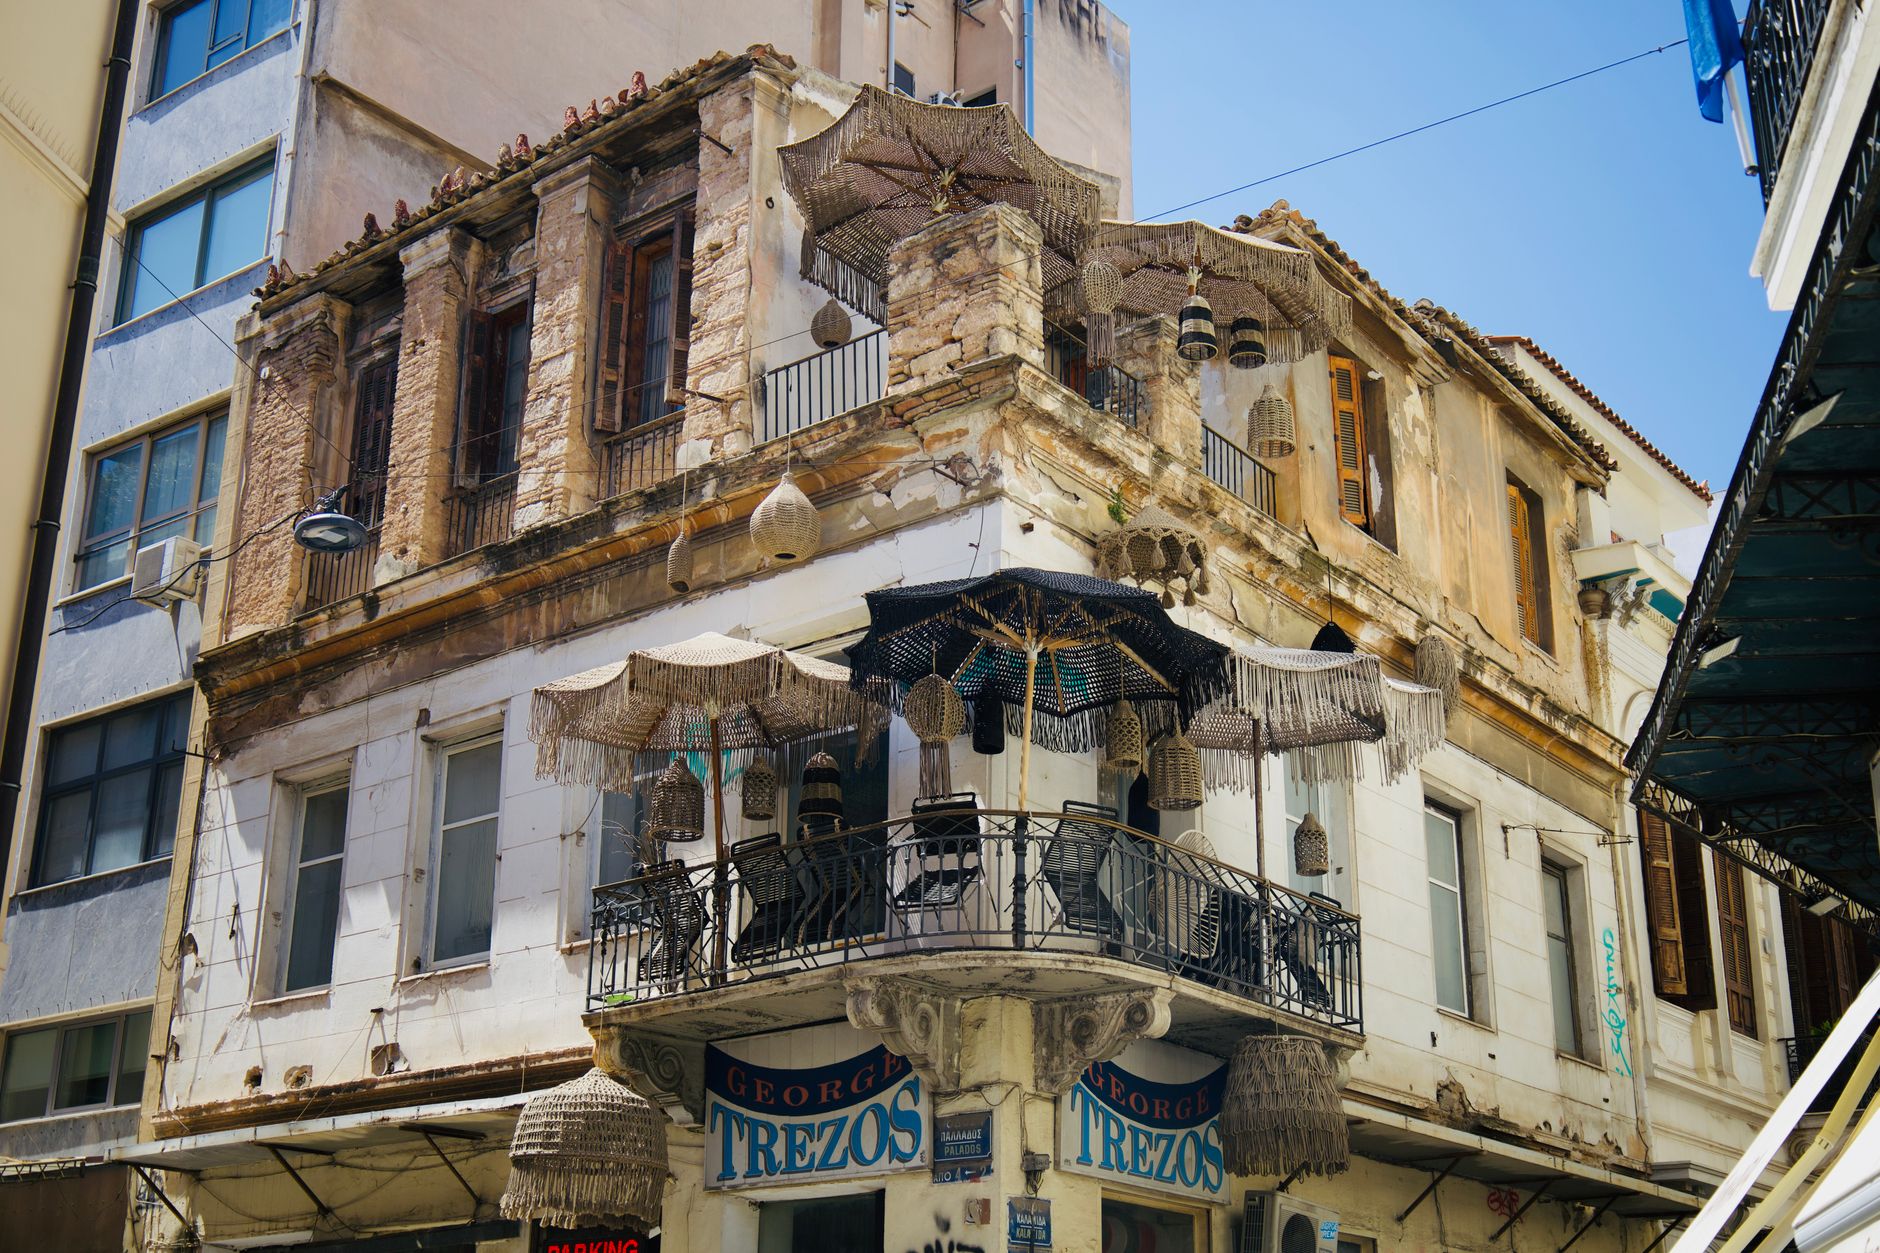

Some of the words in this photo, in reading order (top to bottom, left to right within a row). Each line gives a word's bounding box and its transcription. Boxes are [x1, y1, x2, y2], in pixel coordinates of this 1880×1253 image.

[727, 1051, 902, 1107] GEORGE
[1088, 1061, 1209, 1120] GEORGE
[710, 1075, 922, 1182] TREZOS
[940, 1128, 982, 1142] ΠΑΛΛΑΔΟΣ
[944, 1144, 982, 1156] PALADOS
[1071, 1082, 1224, 1194] TREZOS
[1016, 1227, 1046, 1240] KALAIDA
